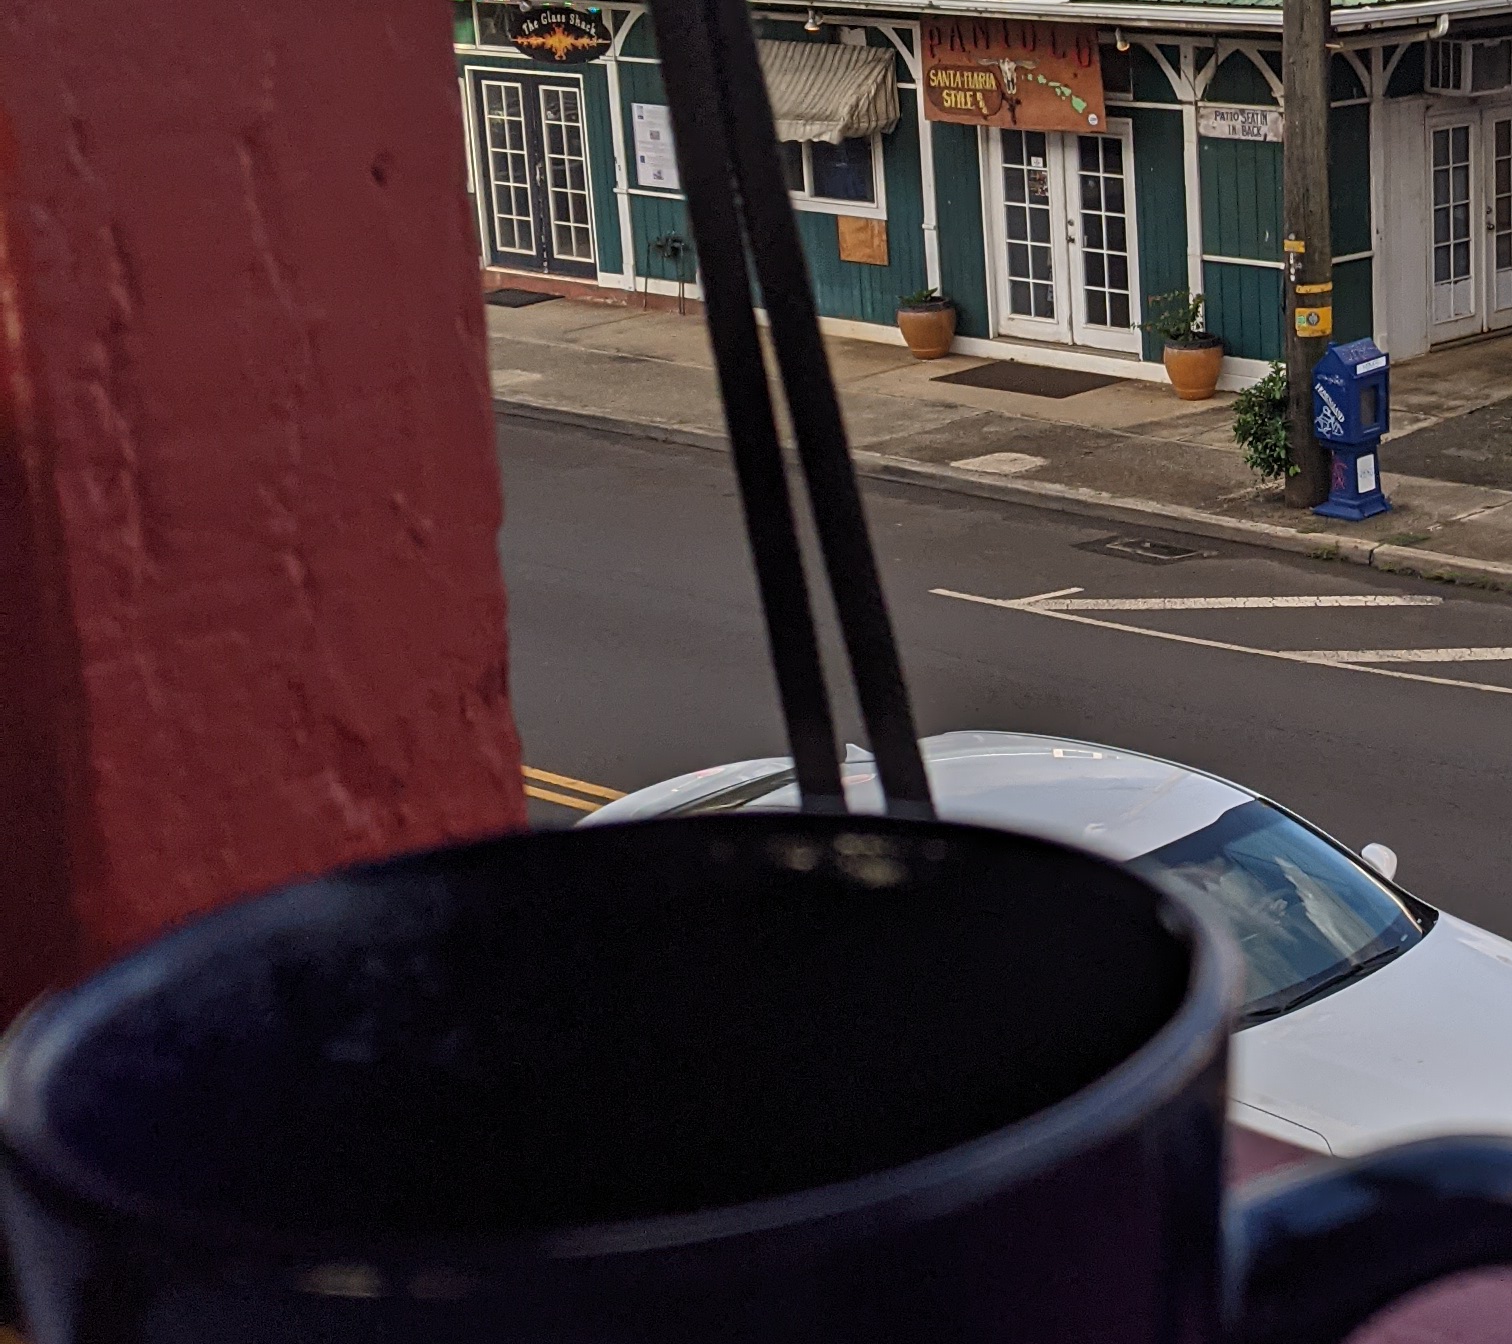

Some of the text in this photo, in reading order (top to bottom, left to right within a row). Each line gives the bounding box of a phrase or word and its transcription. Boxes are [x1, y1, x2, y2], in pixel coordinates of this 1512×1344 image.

[522, 10, 596, 36] The Glass Shack
[942, 89, 975, 110] STYLE
[1214, 110, 1240, 122] PATIO
[1228, 124, 1262, 138] IN BACK
